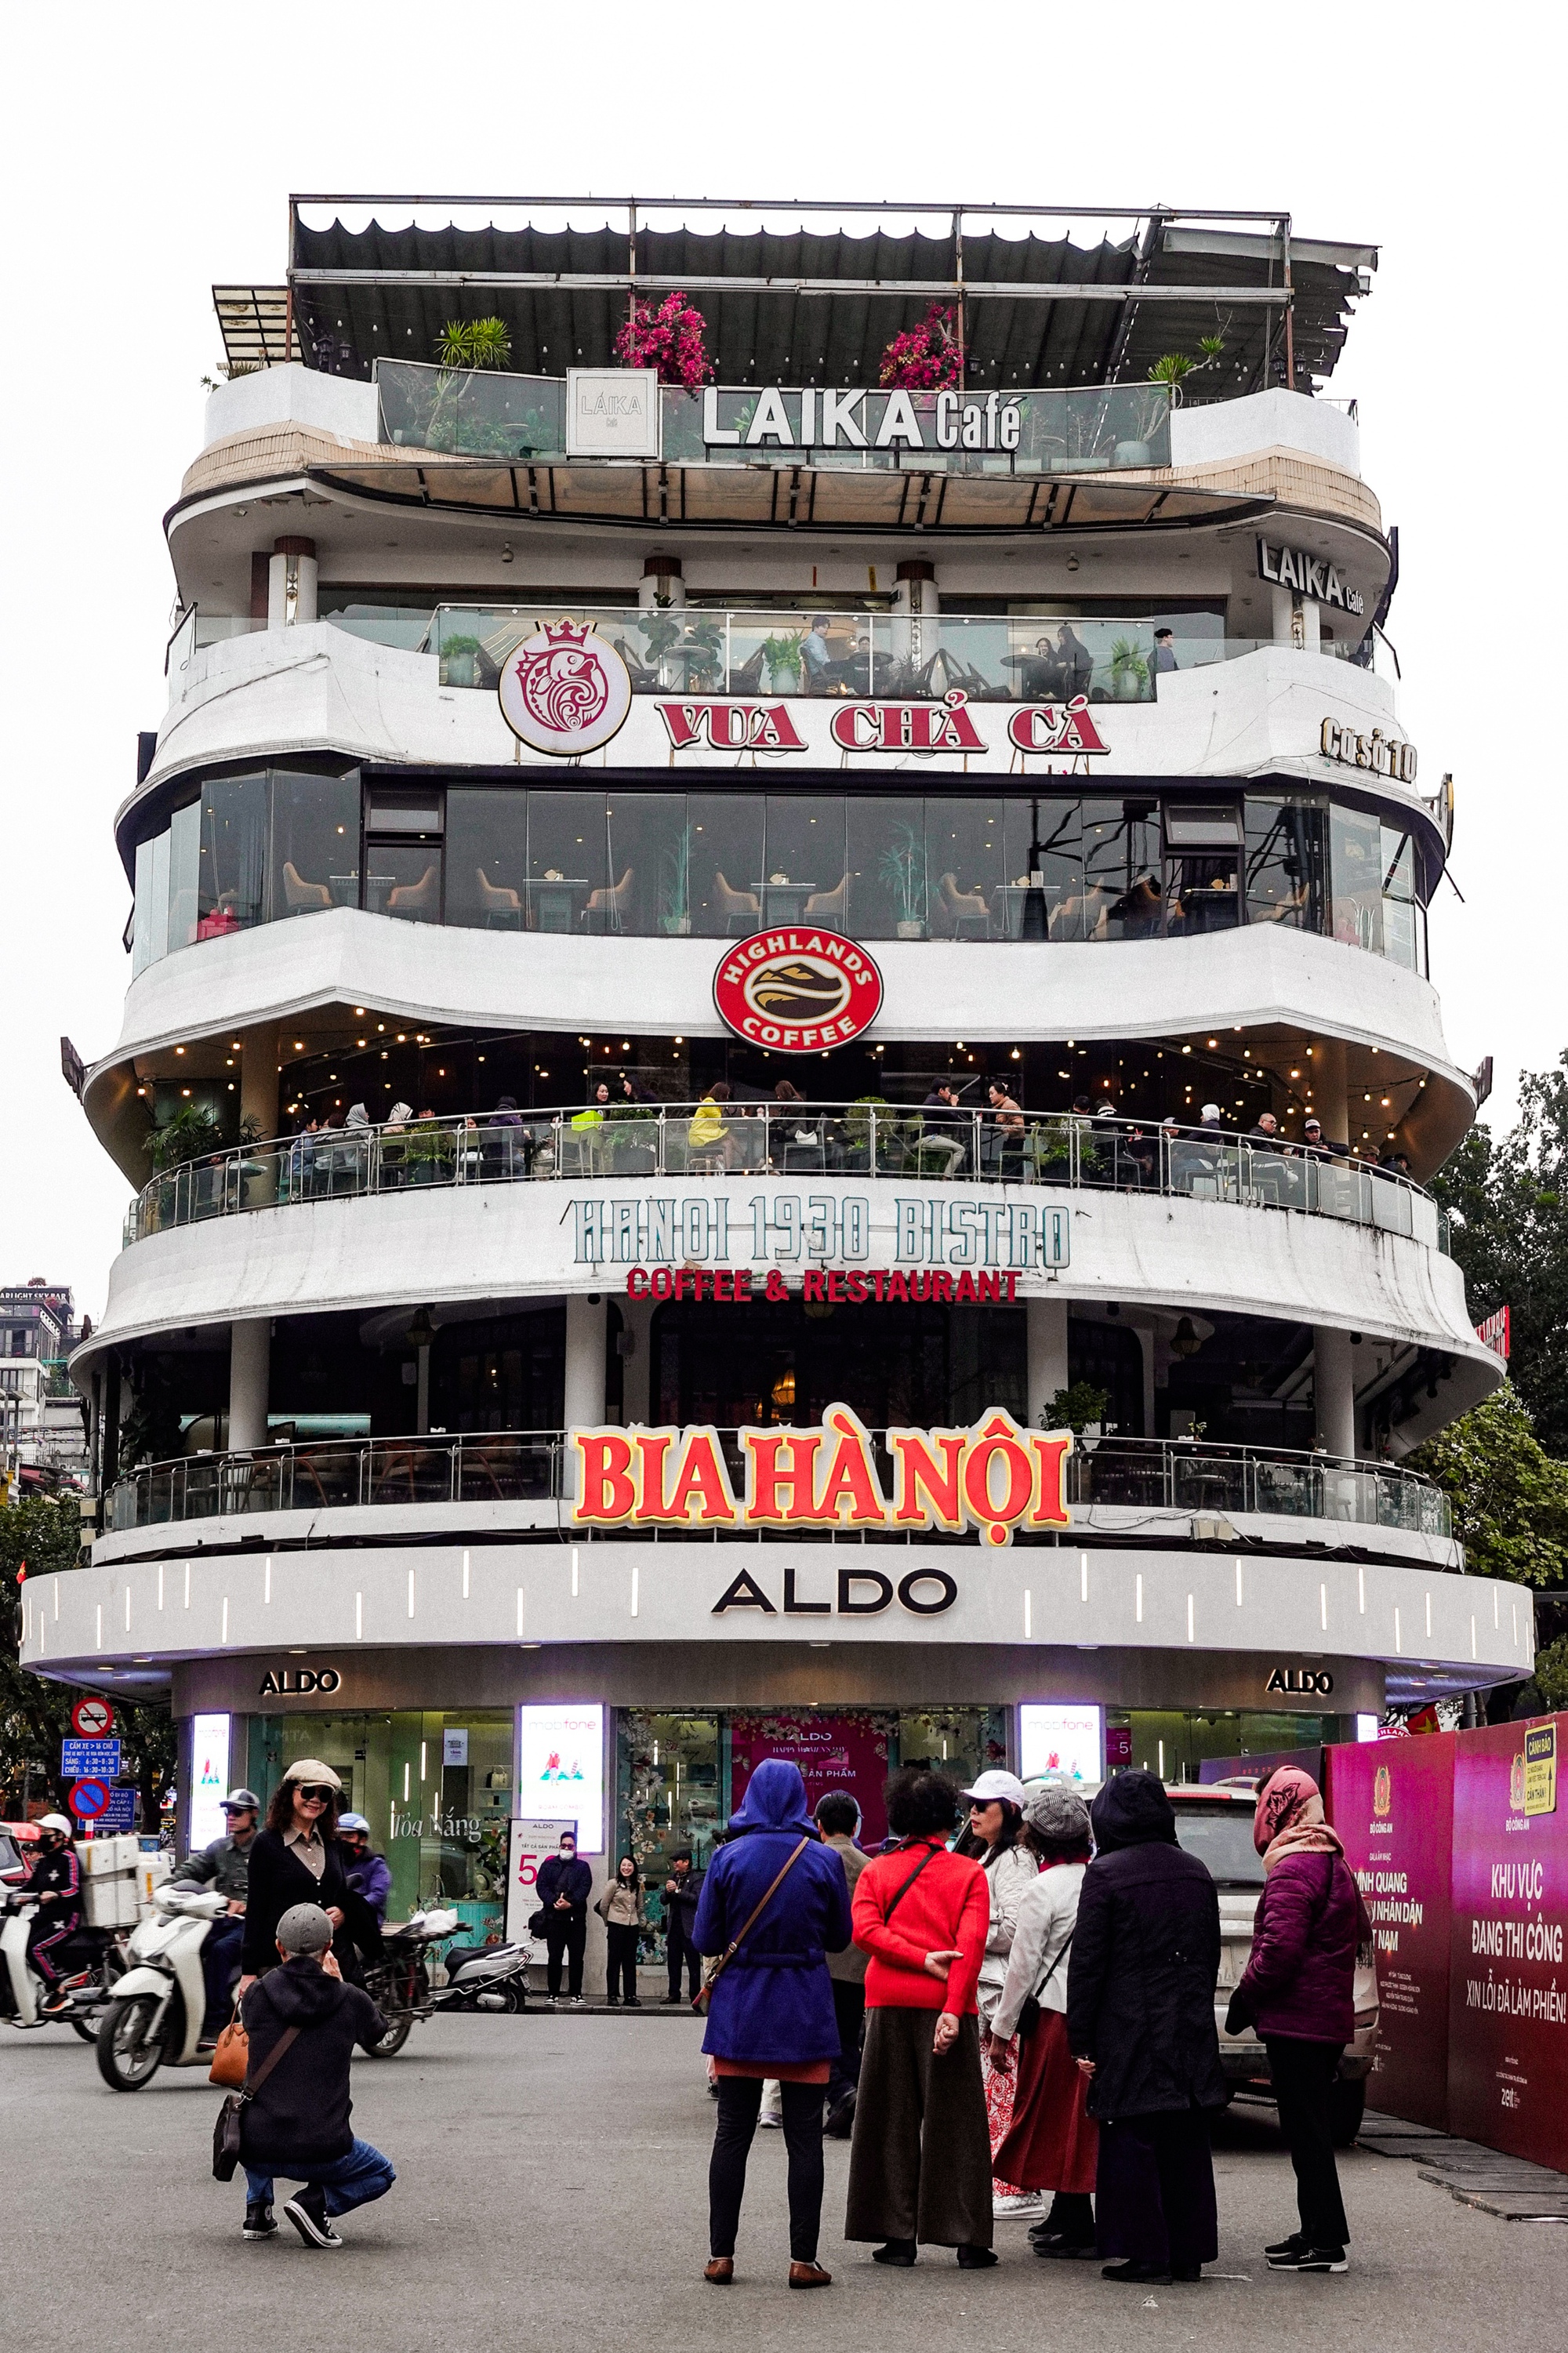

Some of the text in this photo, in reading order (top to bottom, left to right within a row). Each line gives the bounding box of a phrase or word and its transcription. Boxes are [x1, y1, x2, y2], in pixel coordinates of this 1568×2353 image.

[702, 387, 1028, 449] LAIKA Café
[1260, 538, 1364, 615] LAIKA Café
[655, 688, 1111, 755] VUA CHẢ CÁ
[1320, 717, 1417, 782] Cơ sở 10
[723, 934, 873, 986] HIGHLANDS
[742, 1015, 857, 1047] COFFEE
[573, 1195, 1071, 1269] HANOI 1930 BISTRO
[626, 1266, 1023, 1303] COFFEE & RESTAURANT
[573, 1408, 1071, 1548] BIA HÀ NỘI
[710, 1567, 959, 1616] ALDO
[259, 1669, 341, 1695] ALDO
[1265, 1669, 1334, 1695] ALDO
[528, 1717, 596, 1730] mobifone
[1028, 1718, 1094, 1730] mobifone
[1528, 1738, 1541, 1756] CẢNH
[826, 1767, 856, 1777] PHẨM
[429, 1807, 482, 1843] Nắng
[1512, 1817, 1523, 1831] CÔNG
[1523, 1818, 1530, 1830] AN
[1376, 1872, 1407, 1894] QUANG
[1491, 1858, 1544, 1912] KHU VỰC
[1377, 1896, 1402, 1923] NHÂN
[1403, 1897, 1423, 1925] DÂN
[1378, 1930, 1399, 1952] NAM
[1472, 1912, 1563, 1963] ĐANG THI CÔNG
[1466, 1968, 1566, 2024] XIN LỖI ĐÃ LÀM PHIỀN!
